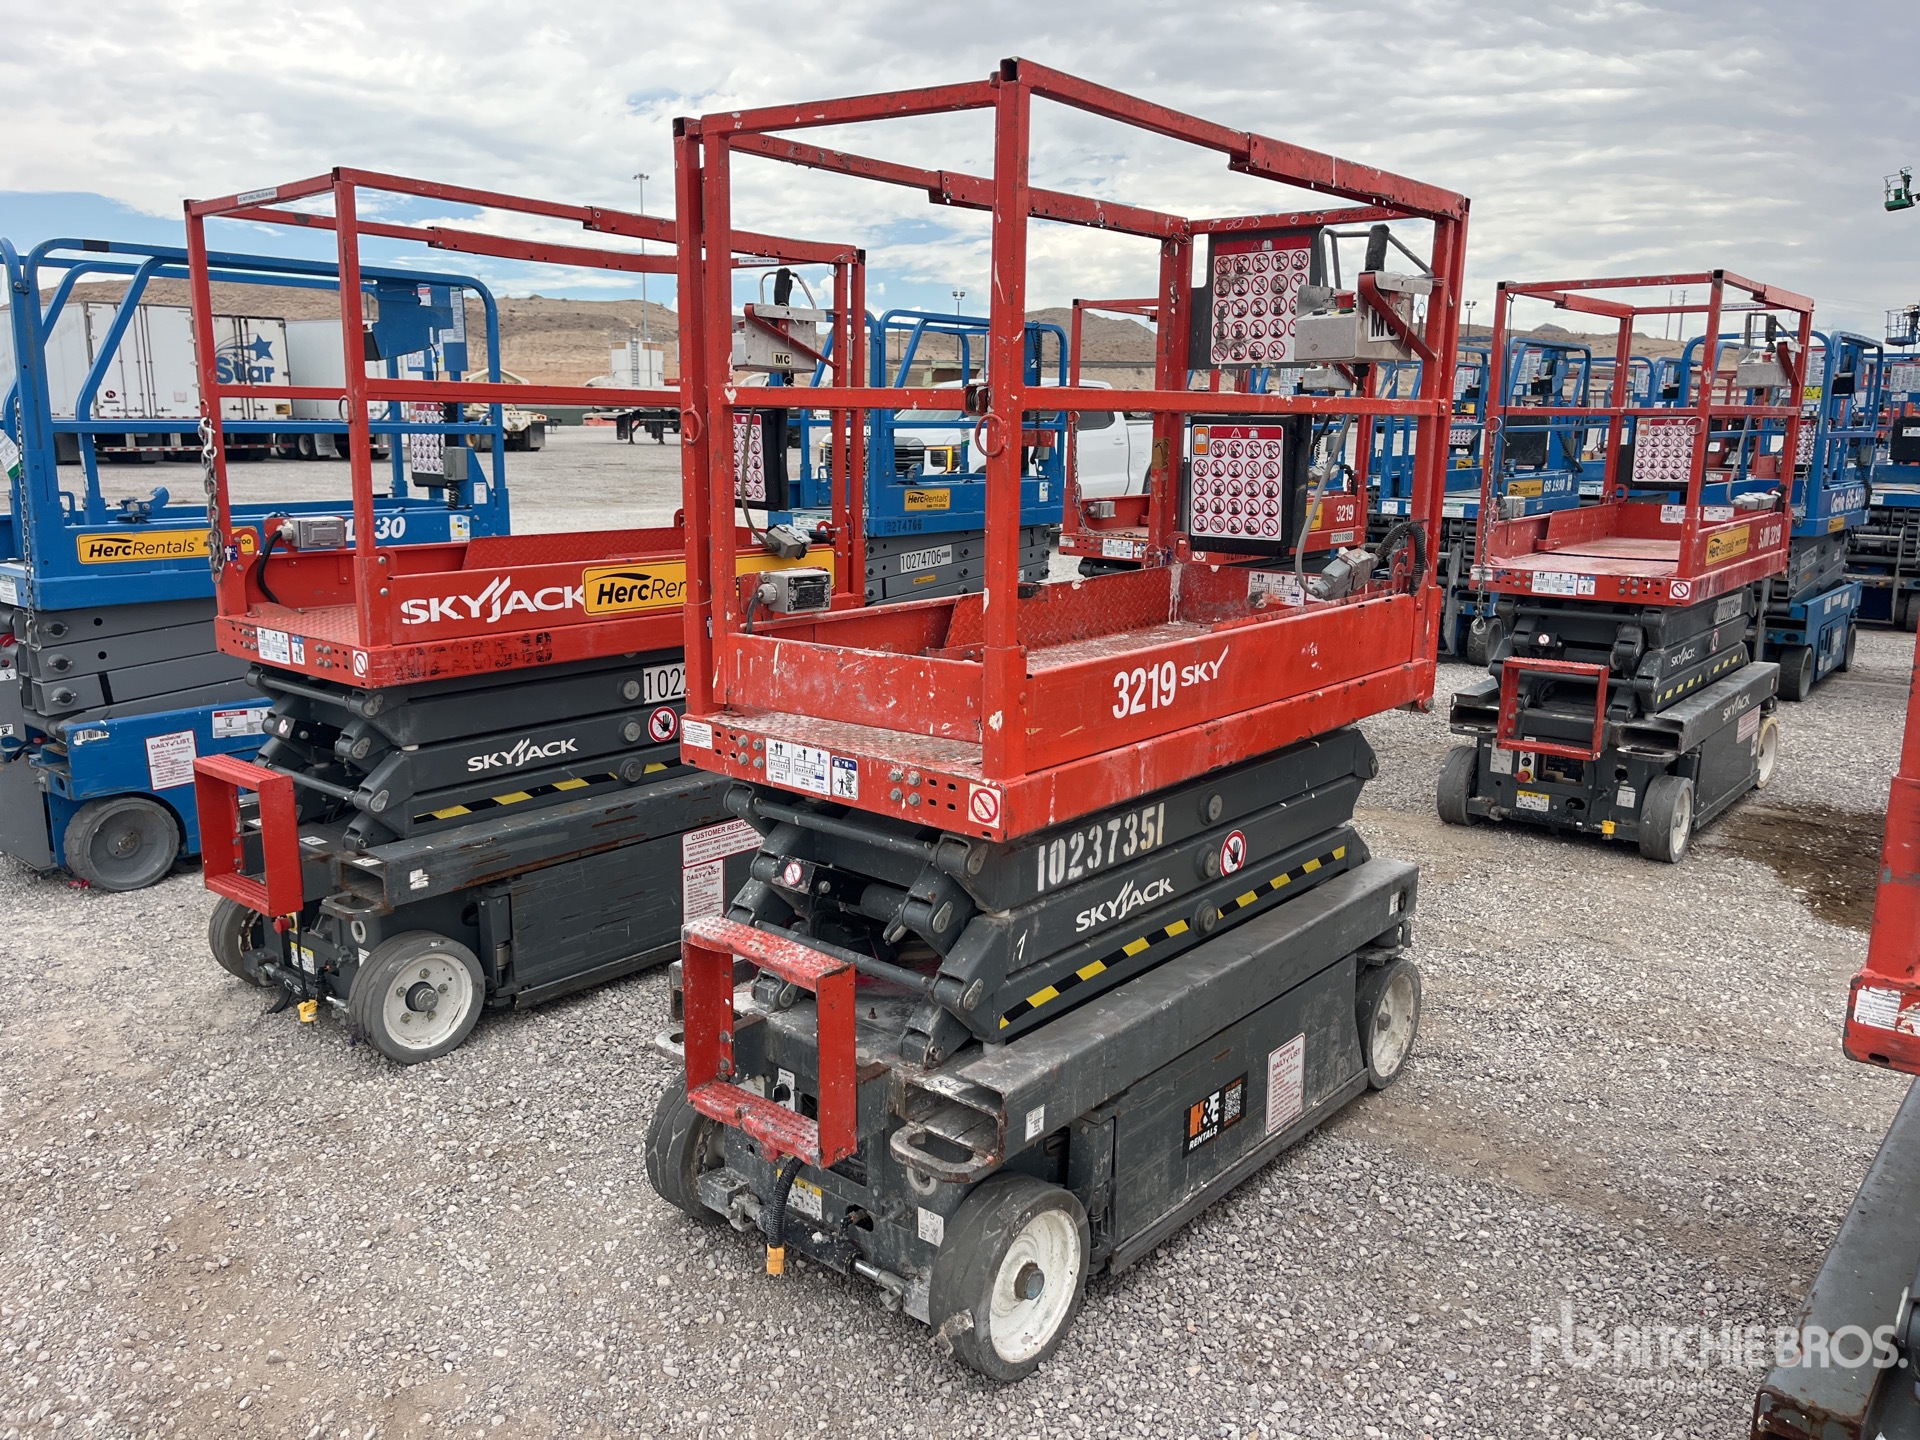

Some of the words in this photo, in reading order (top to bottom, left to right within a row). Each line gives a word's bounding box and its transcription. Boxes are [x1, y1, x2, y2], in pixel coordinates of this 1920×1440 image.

[216, 357, 275, 384] Star
[775, 354, 791, 364] MC
[907, 493, 949, 504] HercRentals
[1336, 504, 1354, 522] 3219
[89, 539, 195, 558] HercRentals
[901, 549, 942, 571] 10274706
[400, 575, 585, 625] SKYJACK
[597, 578, 687, 605] HercRen
[645, 667, 686, 700] 102
[1112, 660, 1176, 719] 3219
[1181, 645, 1229, 687] SKY
[151, 742, 170, 750] DAILY
[467, 738, 579, 772] SKYJACK
[691, 826, 726, 841] CUSTOMER
[727, 821, 748, 831] RESPO
[1037, 802, 1165, 891] 10237351
[686, 872, 703, 881] DAILY
[1075, 878, 1174, 933] SKYJACK
[1272, 1057, 1287, 1071] DAILY
[1290, 1047, 1301, 1060] LIST
[1188, 1124, 1218, 1151] RENTALS
